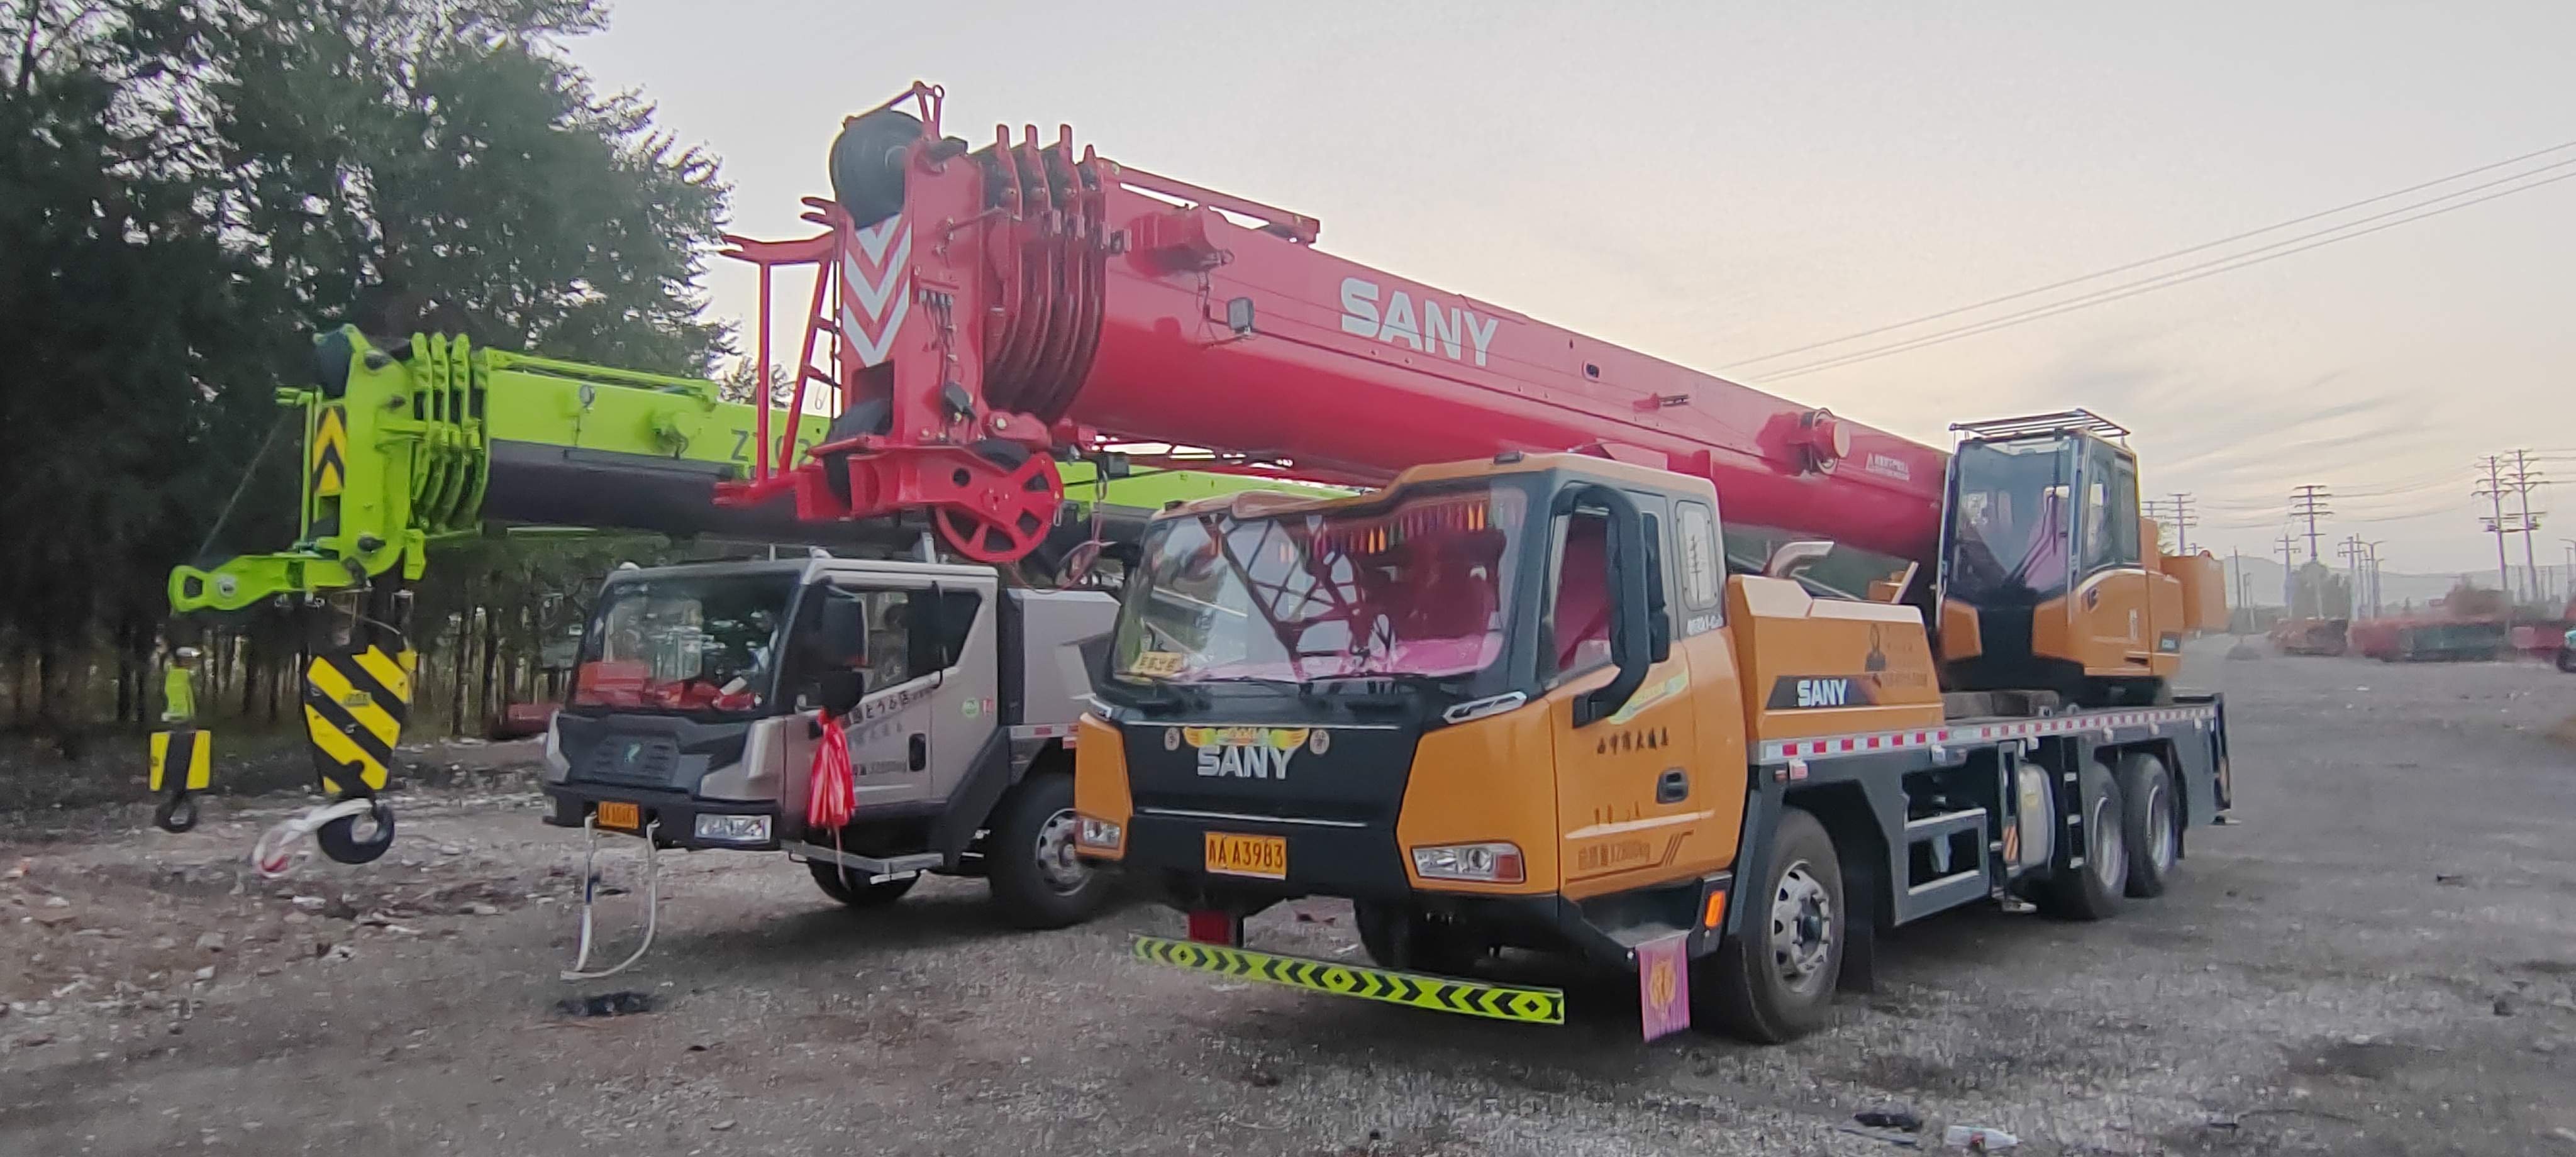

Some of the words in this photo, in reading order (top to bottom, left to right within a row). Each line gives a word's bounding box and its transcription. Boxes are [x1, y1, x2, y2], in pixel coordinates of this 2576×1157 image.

[1341, 277, 1499, 367] SANY
[1797, 678, 1848, 707] SANY
[1197, 745, 1295, 779] SANY
